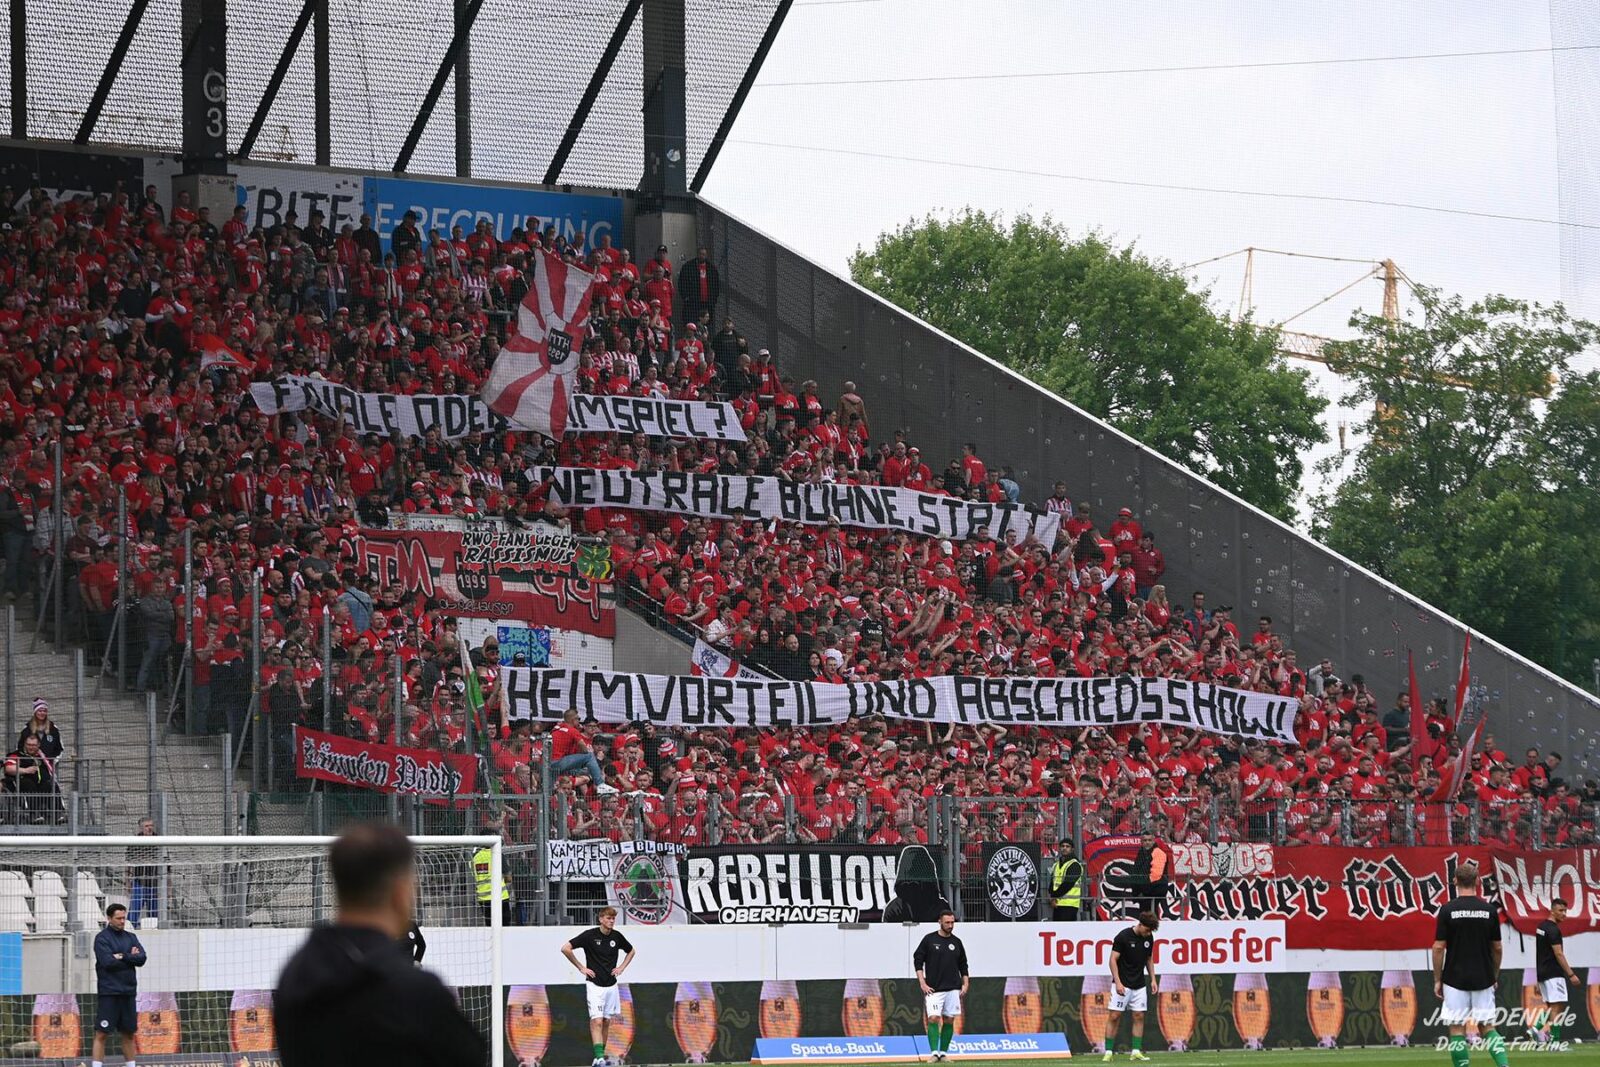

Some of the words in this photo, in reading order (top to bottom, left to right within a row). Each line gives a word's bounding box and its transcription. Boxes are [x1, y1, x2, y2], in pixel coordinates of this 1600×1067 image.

[206, 107, 224, 137] 3
[256, 187, 353, 232] BITE
[541, 468, 765, 518] NEUTRALE
[462, 532, 531, 547] RWO-FANS
[464, 546, 576, 564] RASSISMUS
[457, 574, 487, 588] 1999
[506, 668, 833, 725] HEIMVORTEIL
[848, 679, 938, 718] UND
[953, 675, 1288, 741] ABSCHIEDSSHOW!!
[303, 736, 389, 786] Kämpfen
[550, 842, 609, 859] KÄMPFEN
[1173, 843, 1211, 875] 20
[1235, 843, 1273, 874] 05
[550, 858, 612, 877] MARCO
[687, 853, 897, 913] REBELLION
[1494, 855, 1584, 917] RWO
[722, 907, 858, 923] OBERHAUSEN
[1450, 909, 1490, 919] OBERHAUSEN
[1038, 928, 1281, 966] Terrransfer
[791, 1042, 886, 1057] Sparda-Bank
[948, 1038, 1039, 1054] Sparda-Bank
